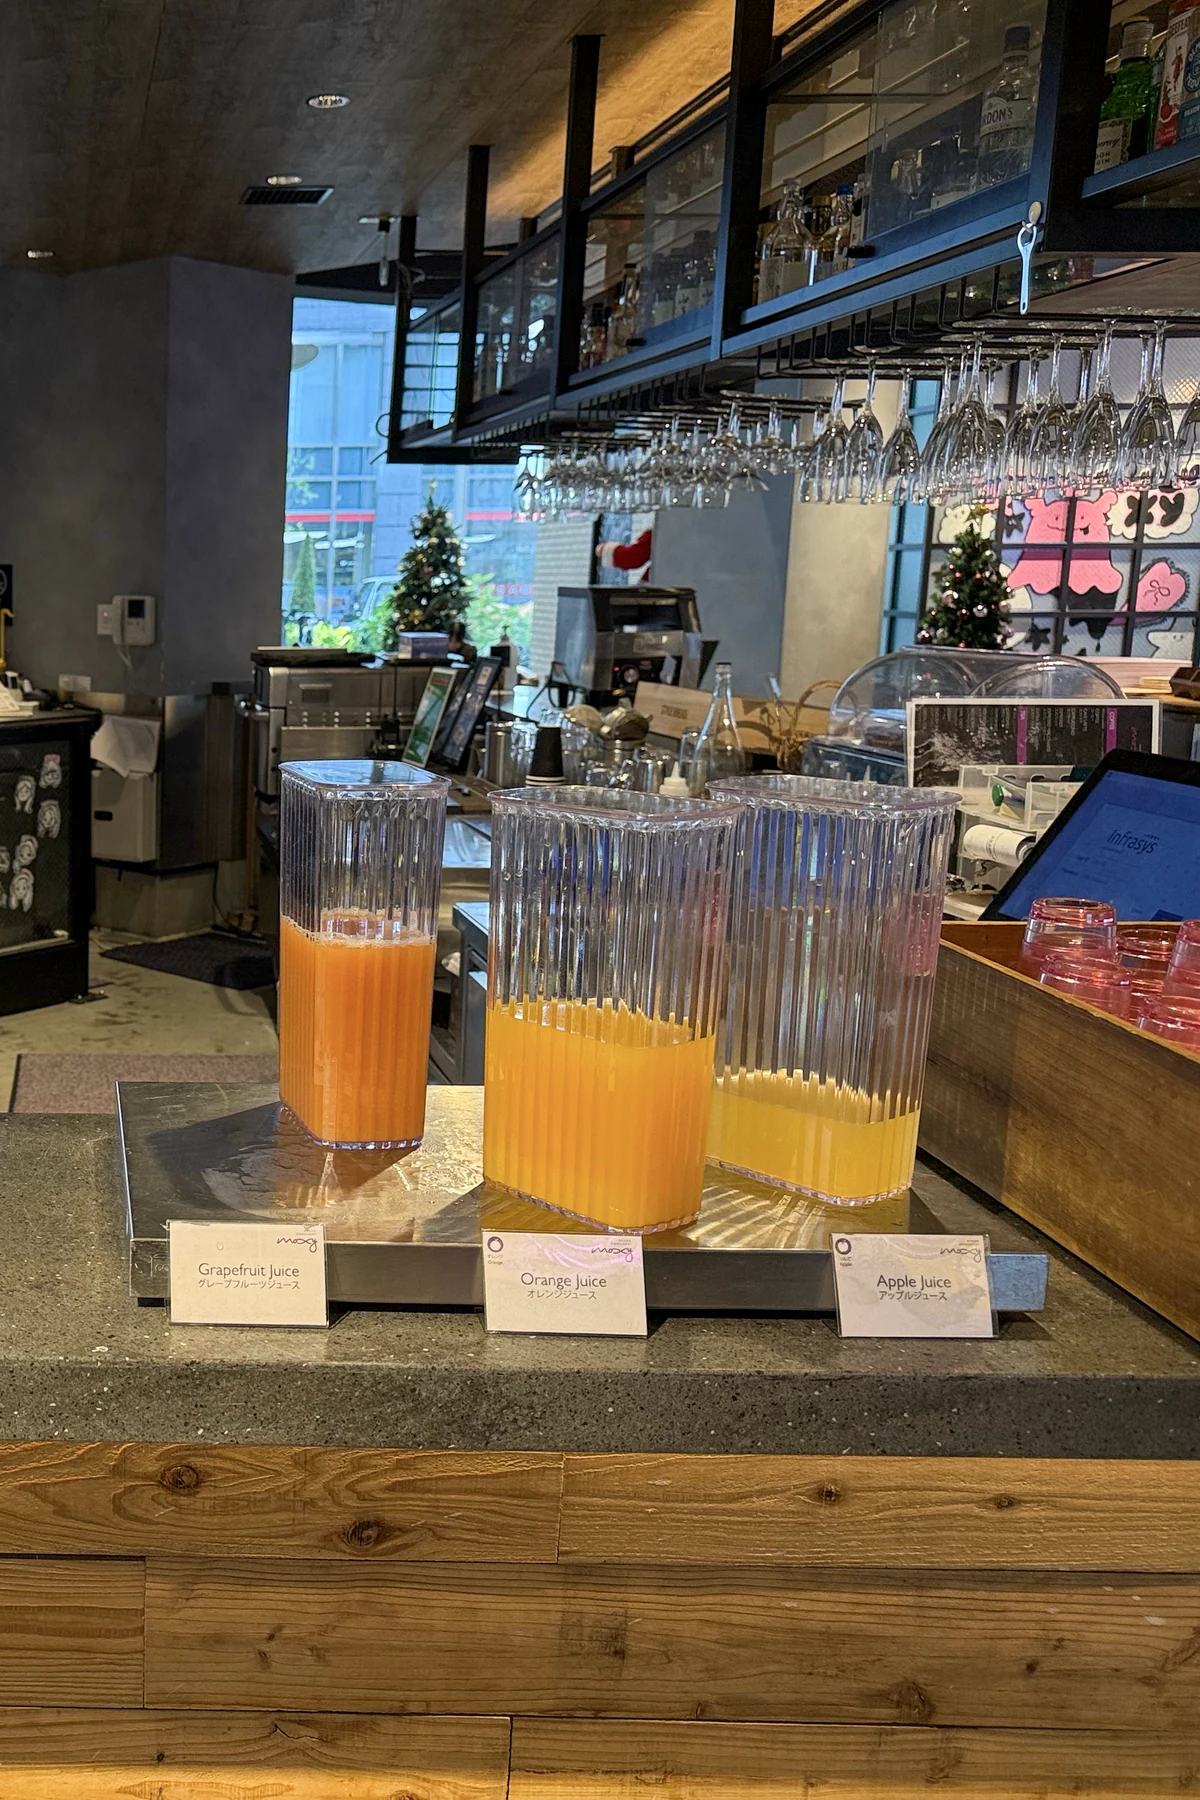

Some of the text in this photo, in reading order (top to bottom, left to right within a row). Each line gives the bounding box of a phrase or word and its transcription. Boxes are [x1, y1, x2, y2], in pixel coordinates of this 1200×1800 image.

[198, 1262, 300, 1279] Grapefruit Juice
[197, 1279, 300, 1290] グレープフルーツジュース
[520, 1272, 607, 1290] Orange Juice
[876, 1274, 952, 1292] Apple Juice
[527, 1289, 597, 1300] オレンジジュース
[879, 1290, 948, 1301] アップルジュース
